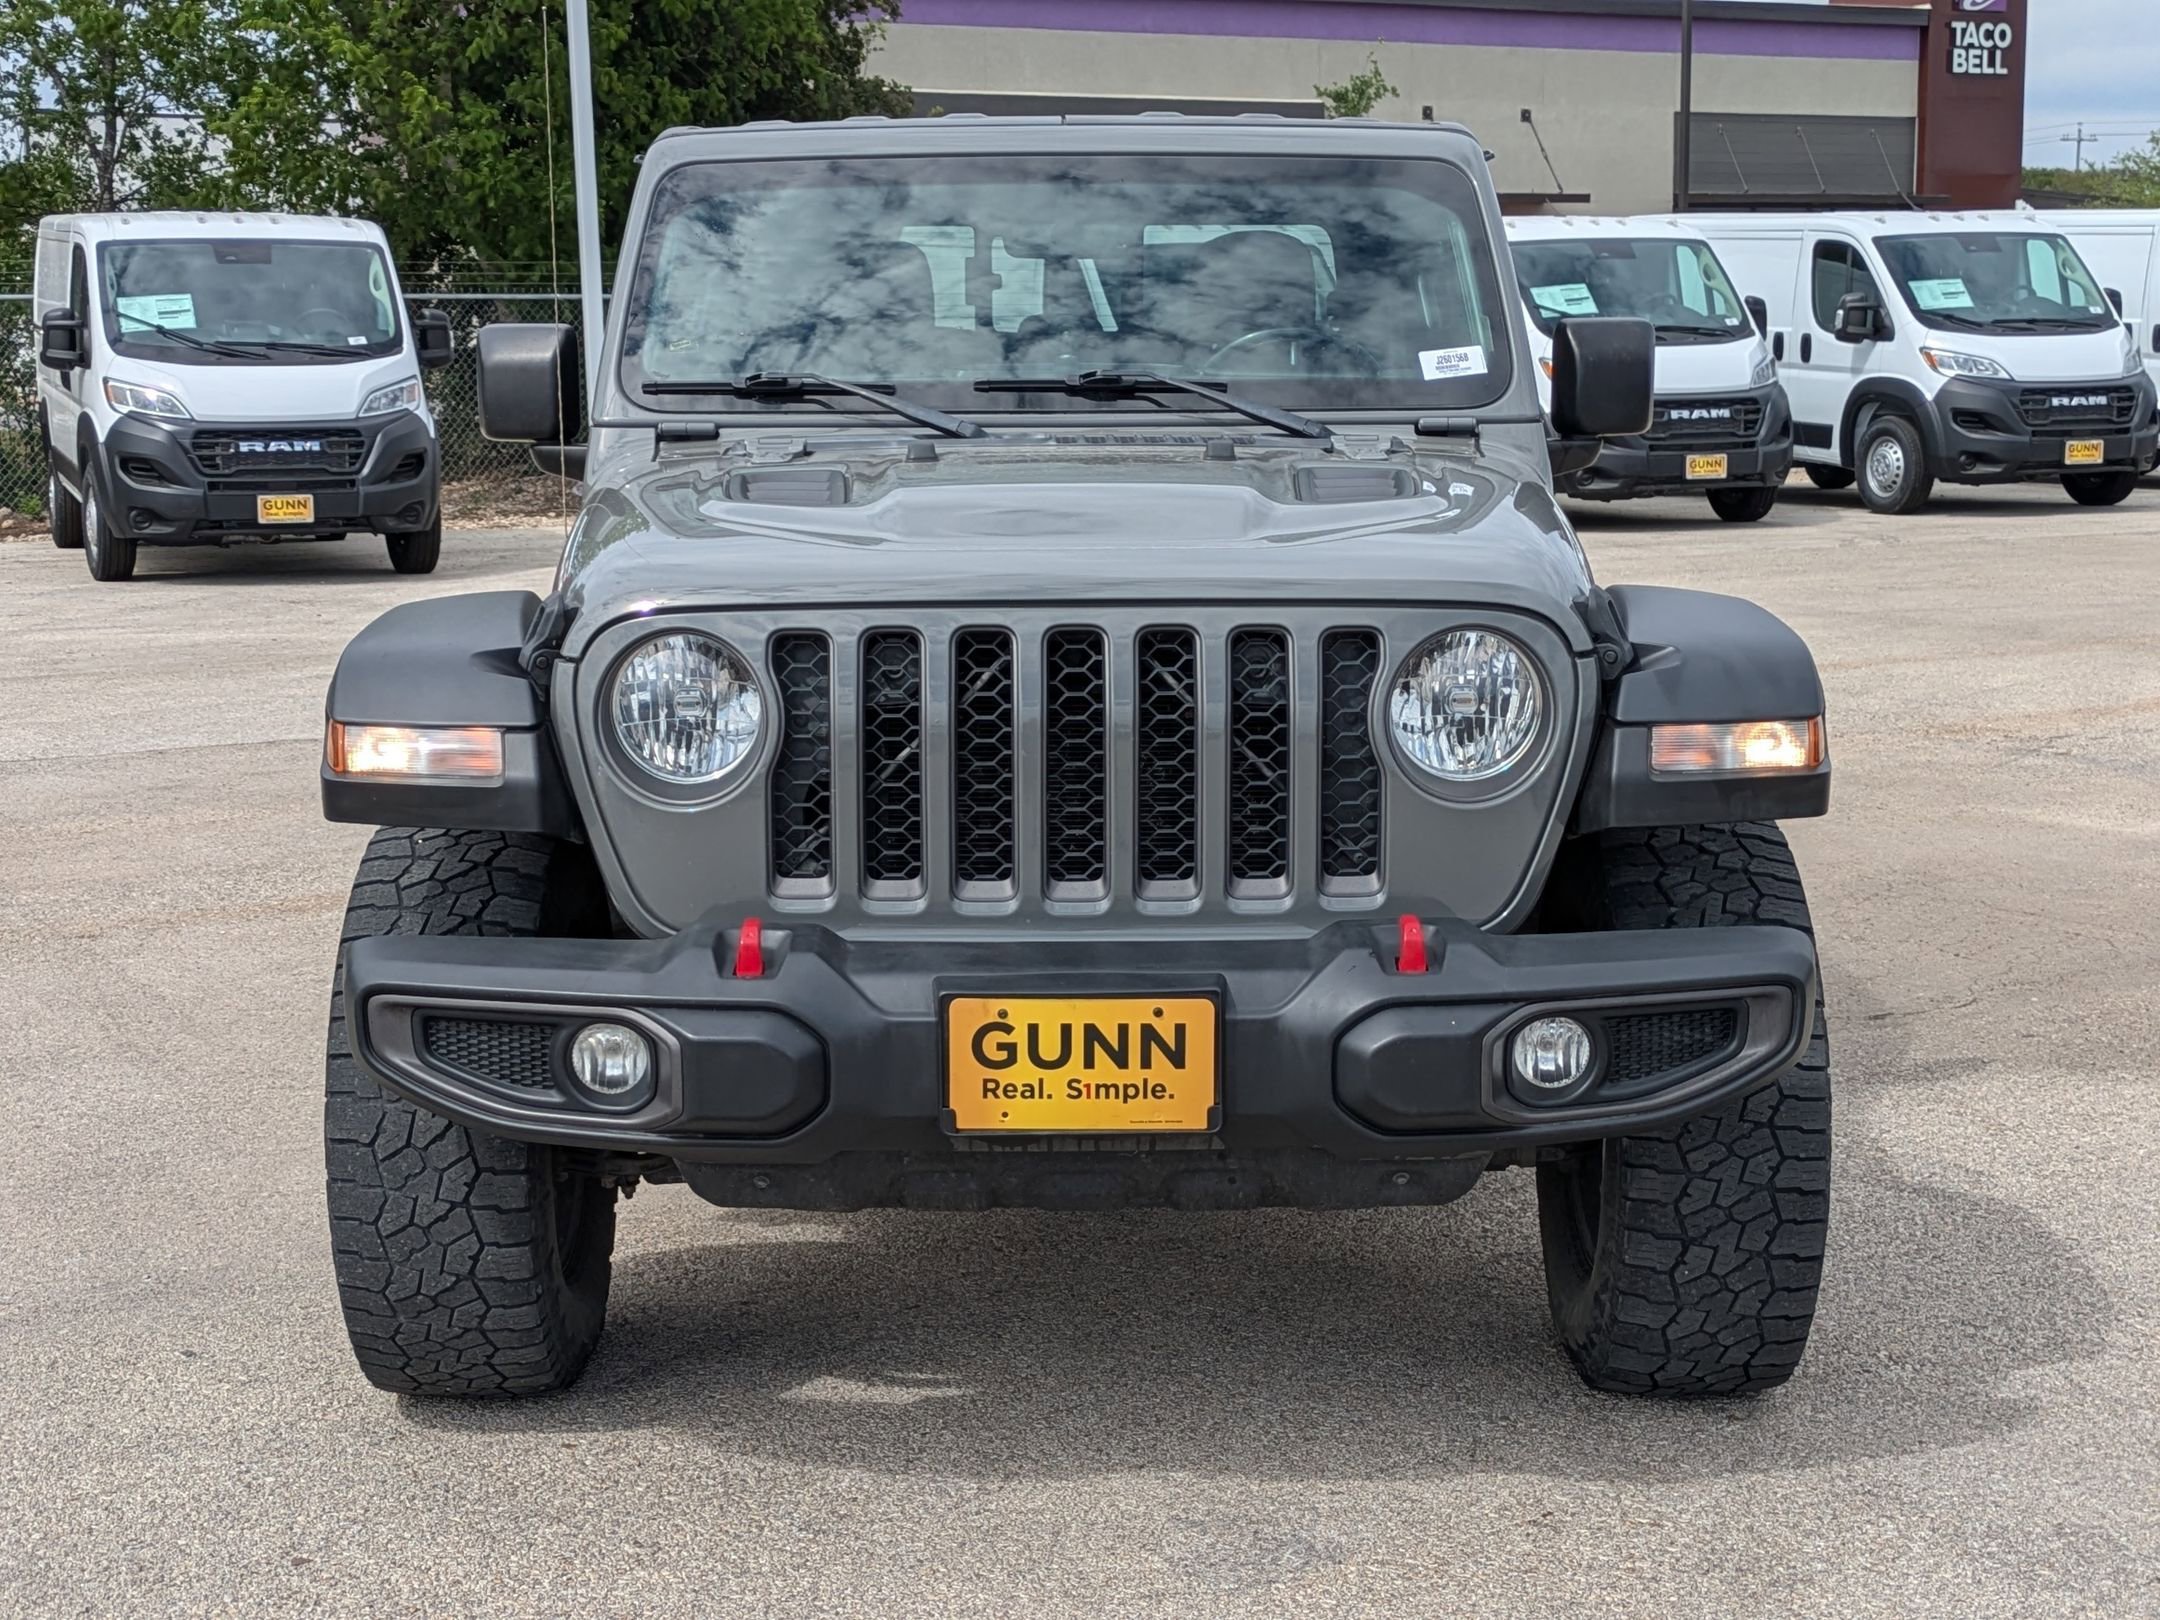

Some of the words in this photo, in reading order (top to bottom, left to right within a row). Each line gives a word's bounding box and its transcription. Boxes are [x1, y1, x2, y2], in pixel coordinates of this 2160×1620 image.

[1951, 21, 2012, 48] TACO
[1952, 48, 2008, 75] BELL
[2051, 395, 2107, 407] RAM
[1670, 408, 1731, 419] RAM
[239, 441, 320, 452] RAM
[2068, 442, 2099, 453] GUNN
[1690, 459, 1722, 469] GUNN
[263, 499, 308, 511] GUNN
[971, 1021, 1187, 1070] GUNN
[982, 1078, 1053, 1100] Real.
